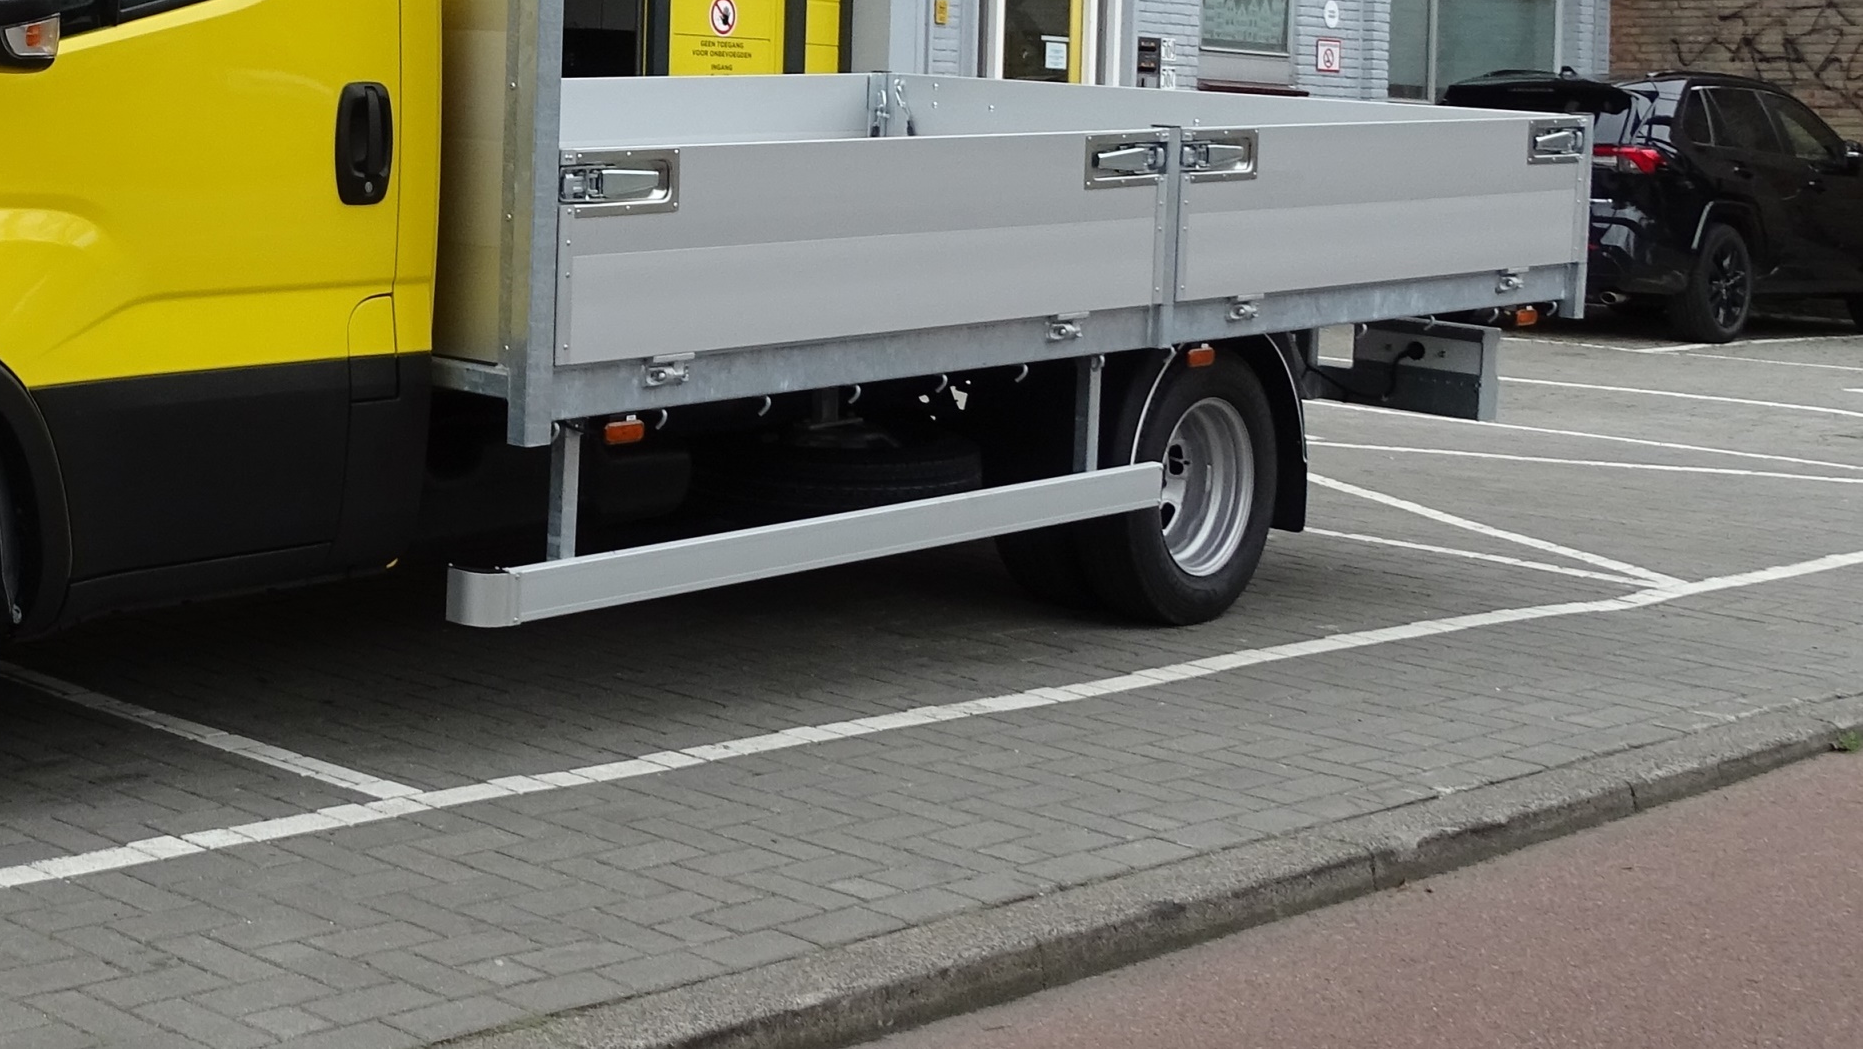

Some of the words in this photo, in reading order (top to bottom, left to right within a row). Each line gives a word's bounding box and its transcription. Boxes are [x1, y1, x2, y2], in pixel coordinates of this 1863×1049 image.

[700, 40, 716, 48] GEEN
[717, 41, 744, 49] TOEGANG
[710, 63, 733, 71] INGANG
